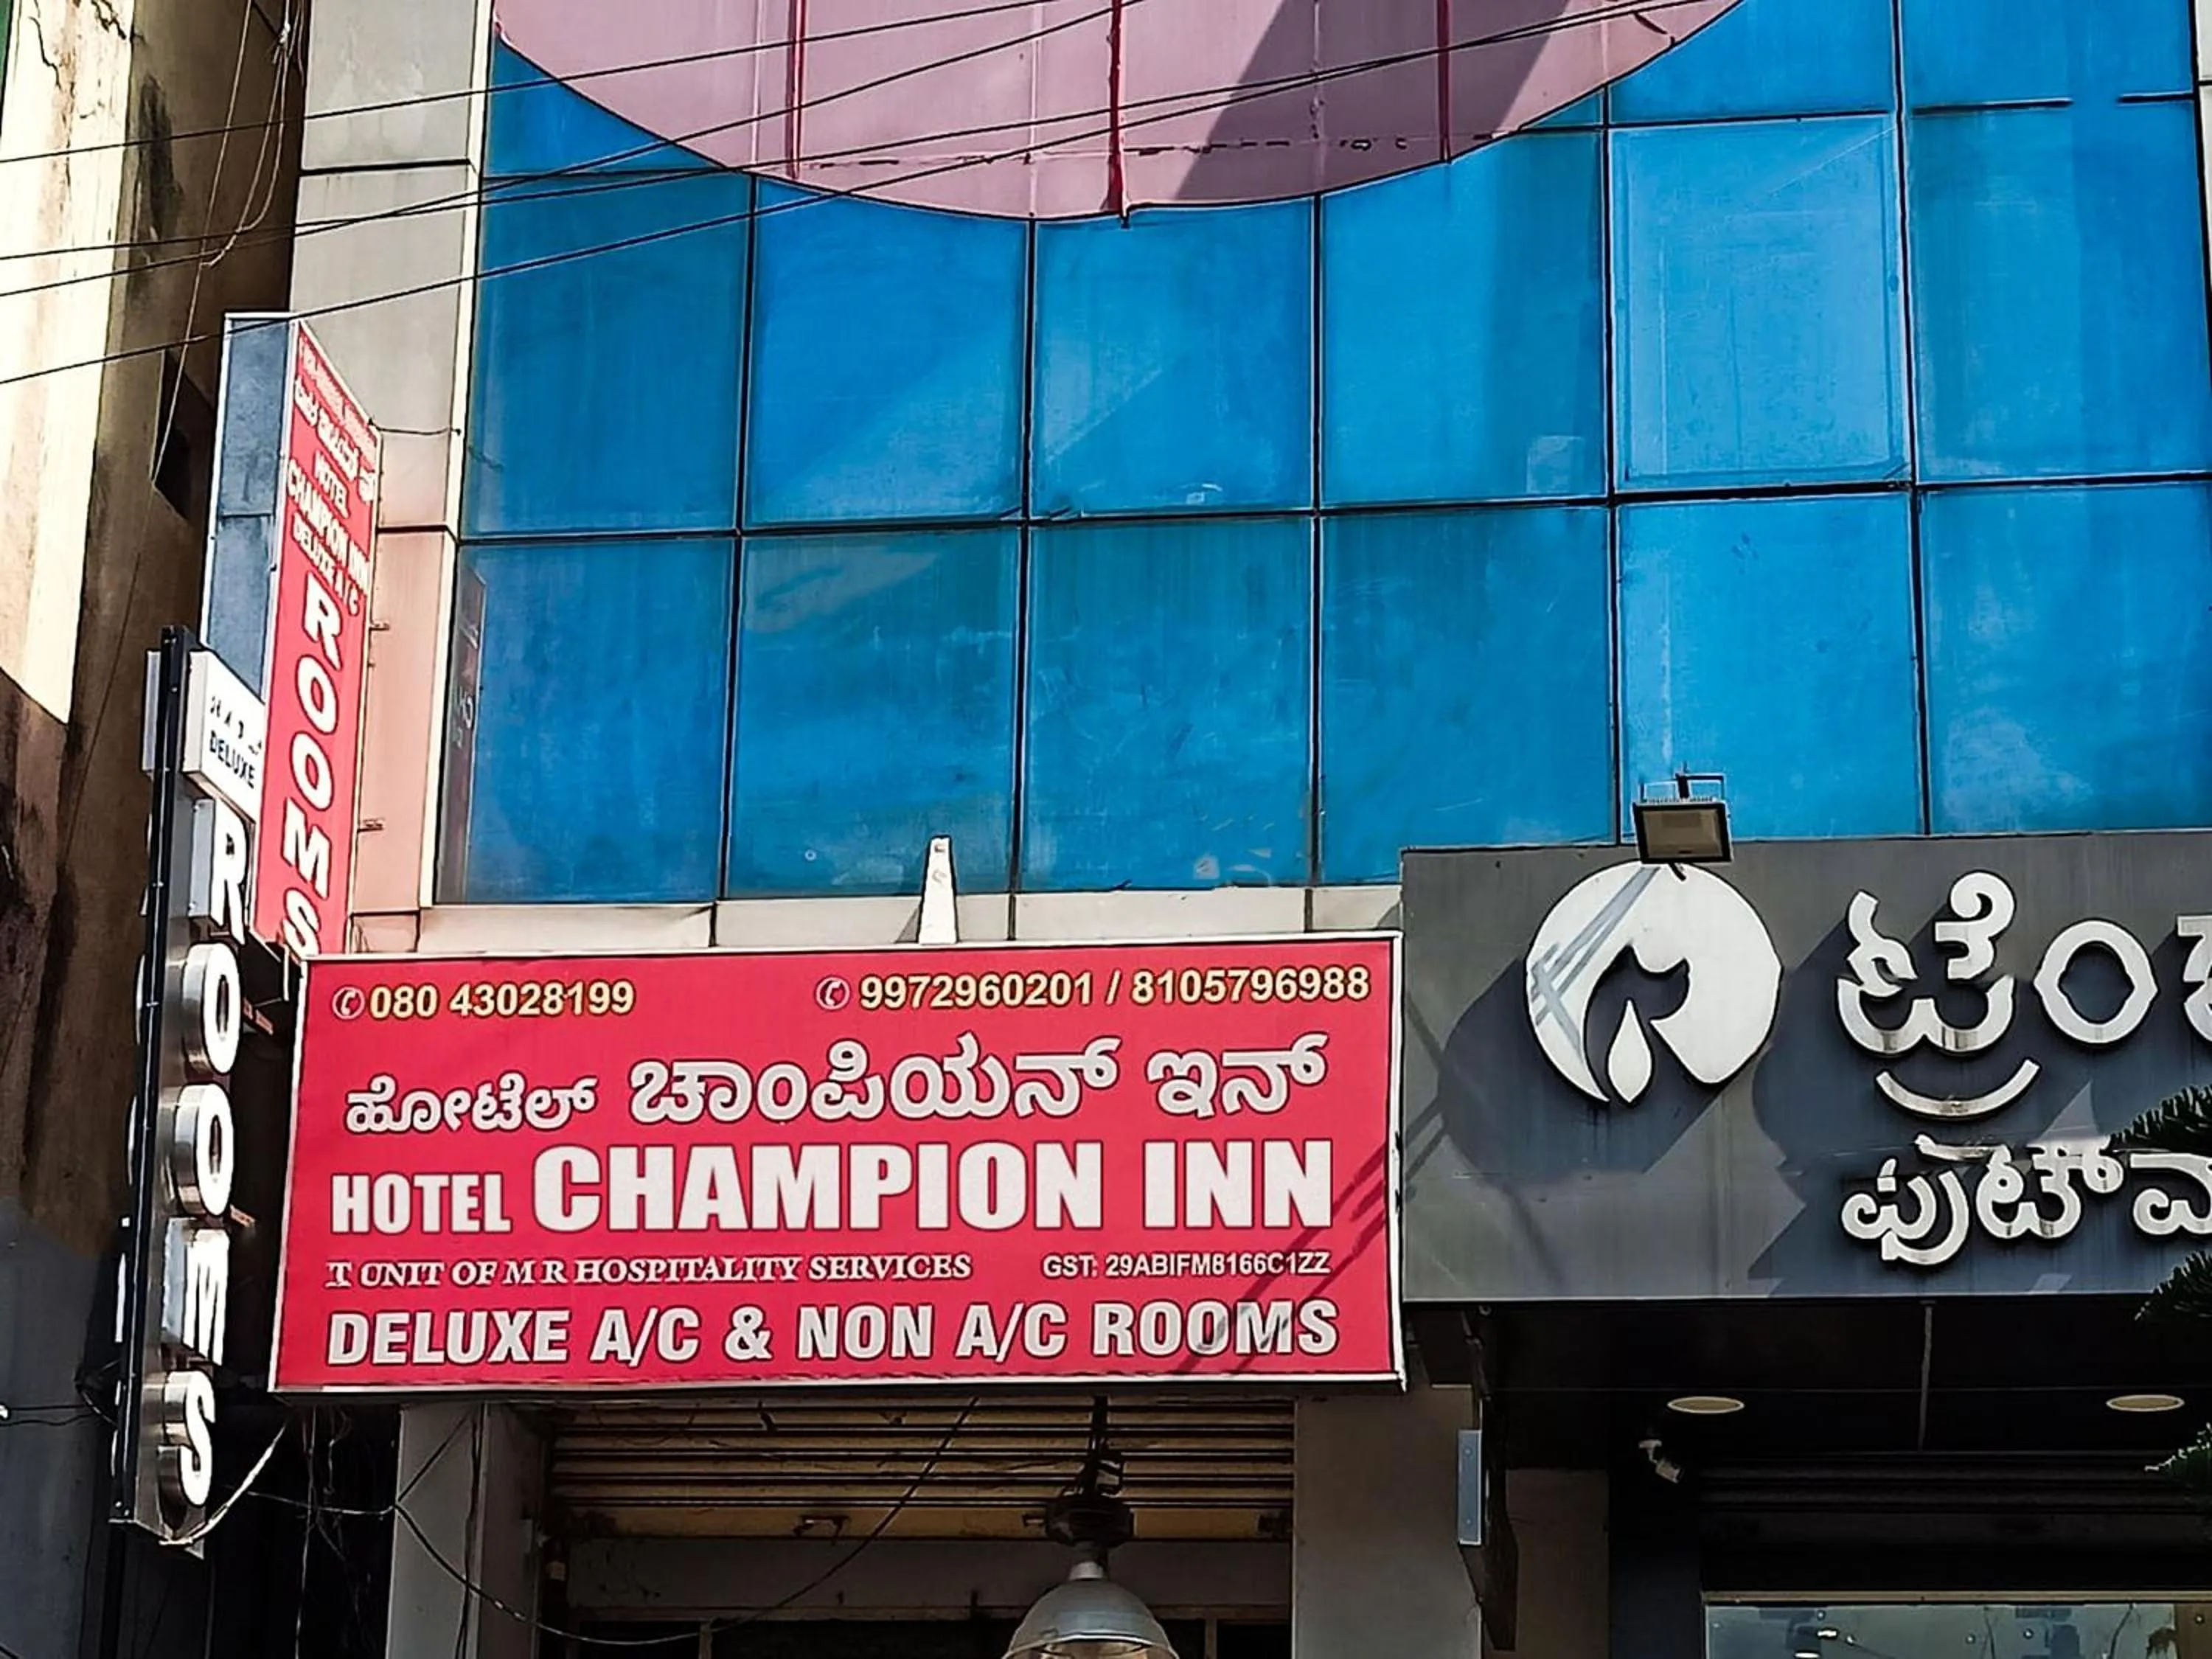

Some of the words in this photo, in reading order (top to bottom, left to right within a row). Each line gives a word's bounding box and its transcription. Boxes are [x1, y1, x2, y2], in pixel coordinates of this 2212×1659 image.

[282, 570, 342, 956] ROOMS
[369, 984, 438, 1019] 080
[448, 981, 635, 1018] 43028199
[860, 972, 1091, 1009] 9972960201
[1106, 969, 1121, 1005] /
[1130, 966, 1369, 1005] 8105796988
[345, 1072, 599, 1133] ಹೋಟೆಲ್
[630, 1032, 1121, 1124] ಚಾಂಪಿಯನ್
[1147, 1032, 1329, 1119] ಇನ್
[332, 1174, 512, 1234] HOTEL
[533, 1142, 1102, 1232] CHAMPION
[1144, 1140, 1332, 1228] INN
[451, 1261, 498, 1286] OF
[574, 1256, 803, 1284] HOSPITALITY
[808, 1253, 973, 1281] SERVICES
[327, 1310, 570, 1365] DELUXE
[589, 1307, 700, 1367] A/C
[724, 1306, 773, 1361] &
[797, 1304, 933, 1359] NON
[955, 1302, 1066, 1363] A/C
[1093, 1299, 1338, 1356] ROOMS
